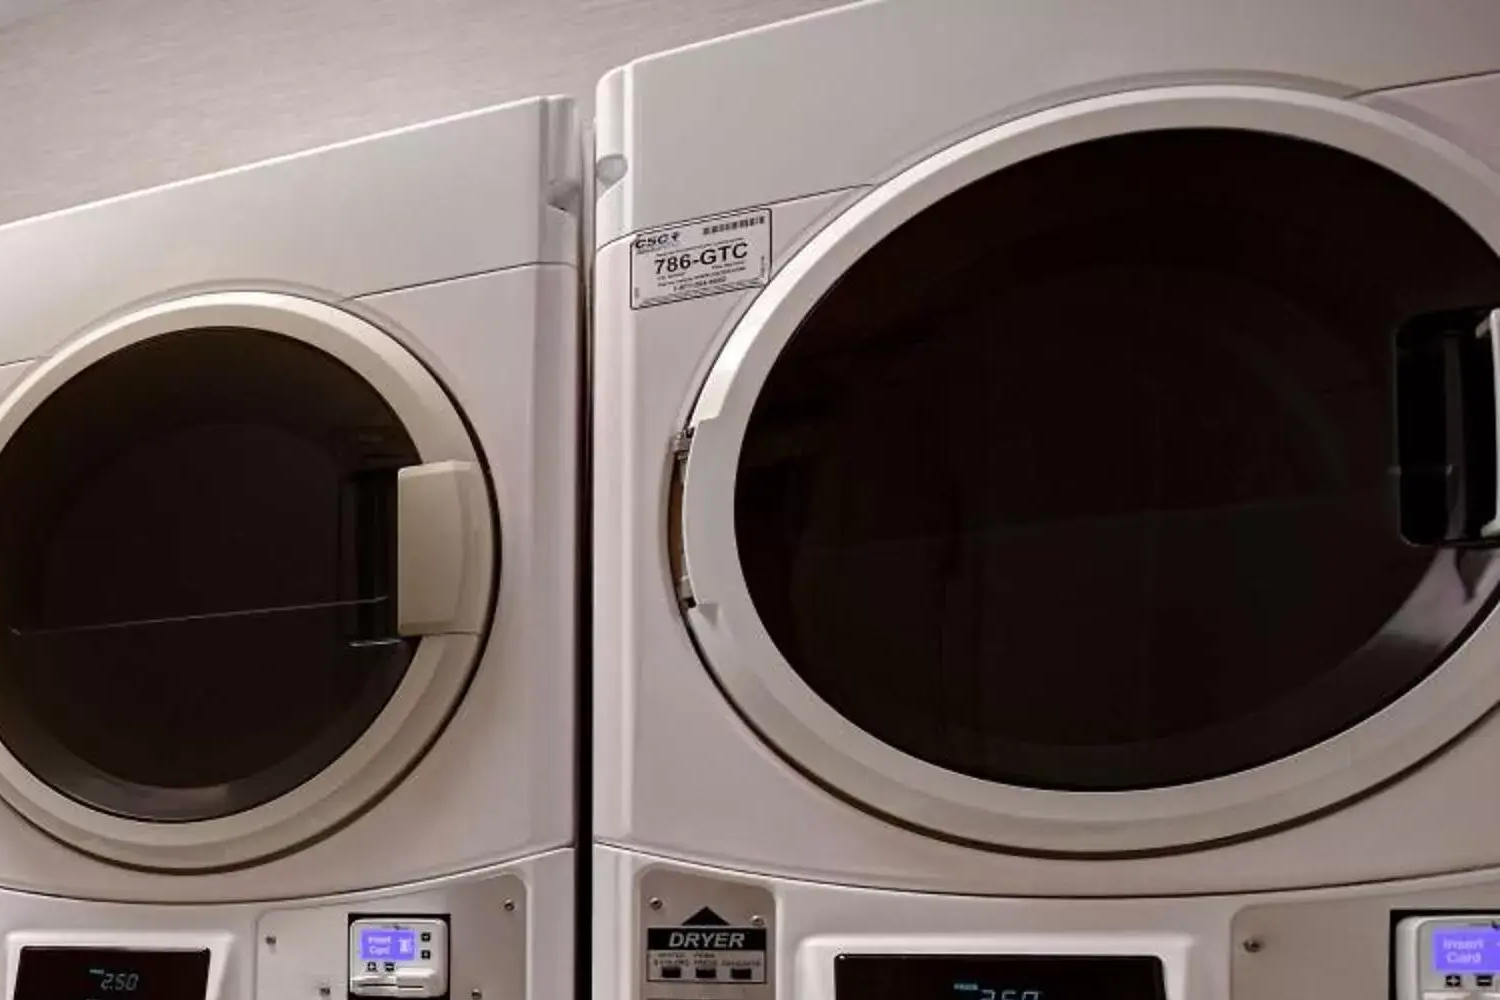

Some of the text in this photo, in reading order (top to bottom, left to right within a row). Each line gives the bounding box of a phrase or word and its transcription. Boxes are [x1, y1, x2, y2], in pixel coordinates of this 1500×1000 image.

[654, 242, 749, 275] 786-GTC
[668, 931, 746, 949] DRYER
[1446, 951, 1482, 964] Card
